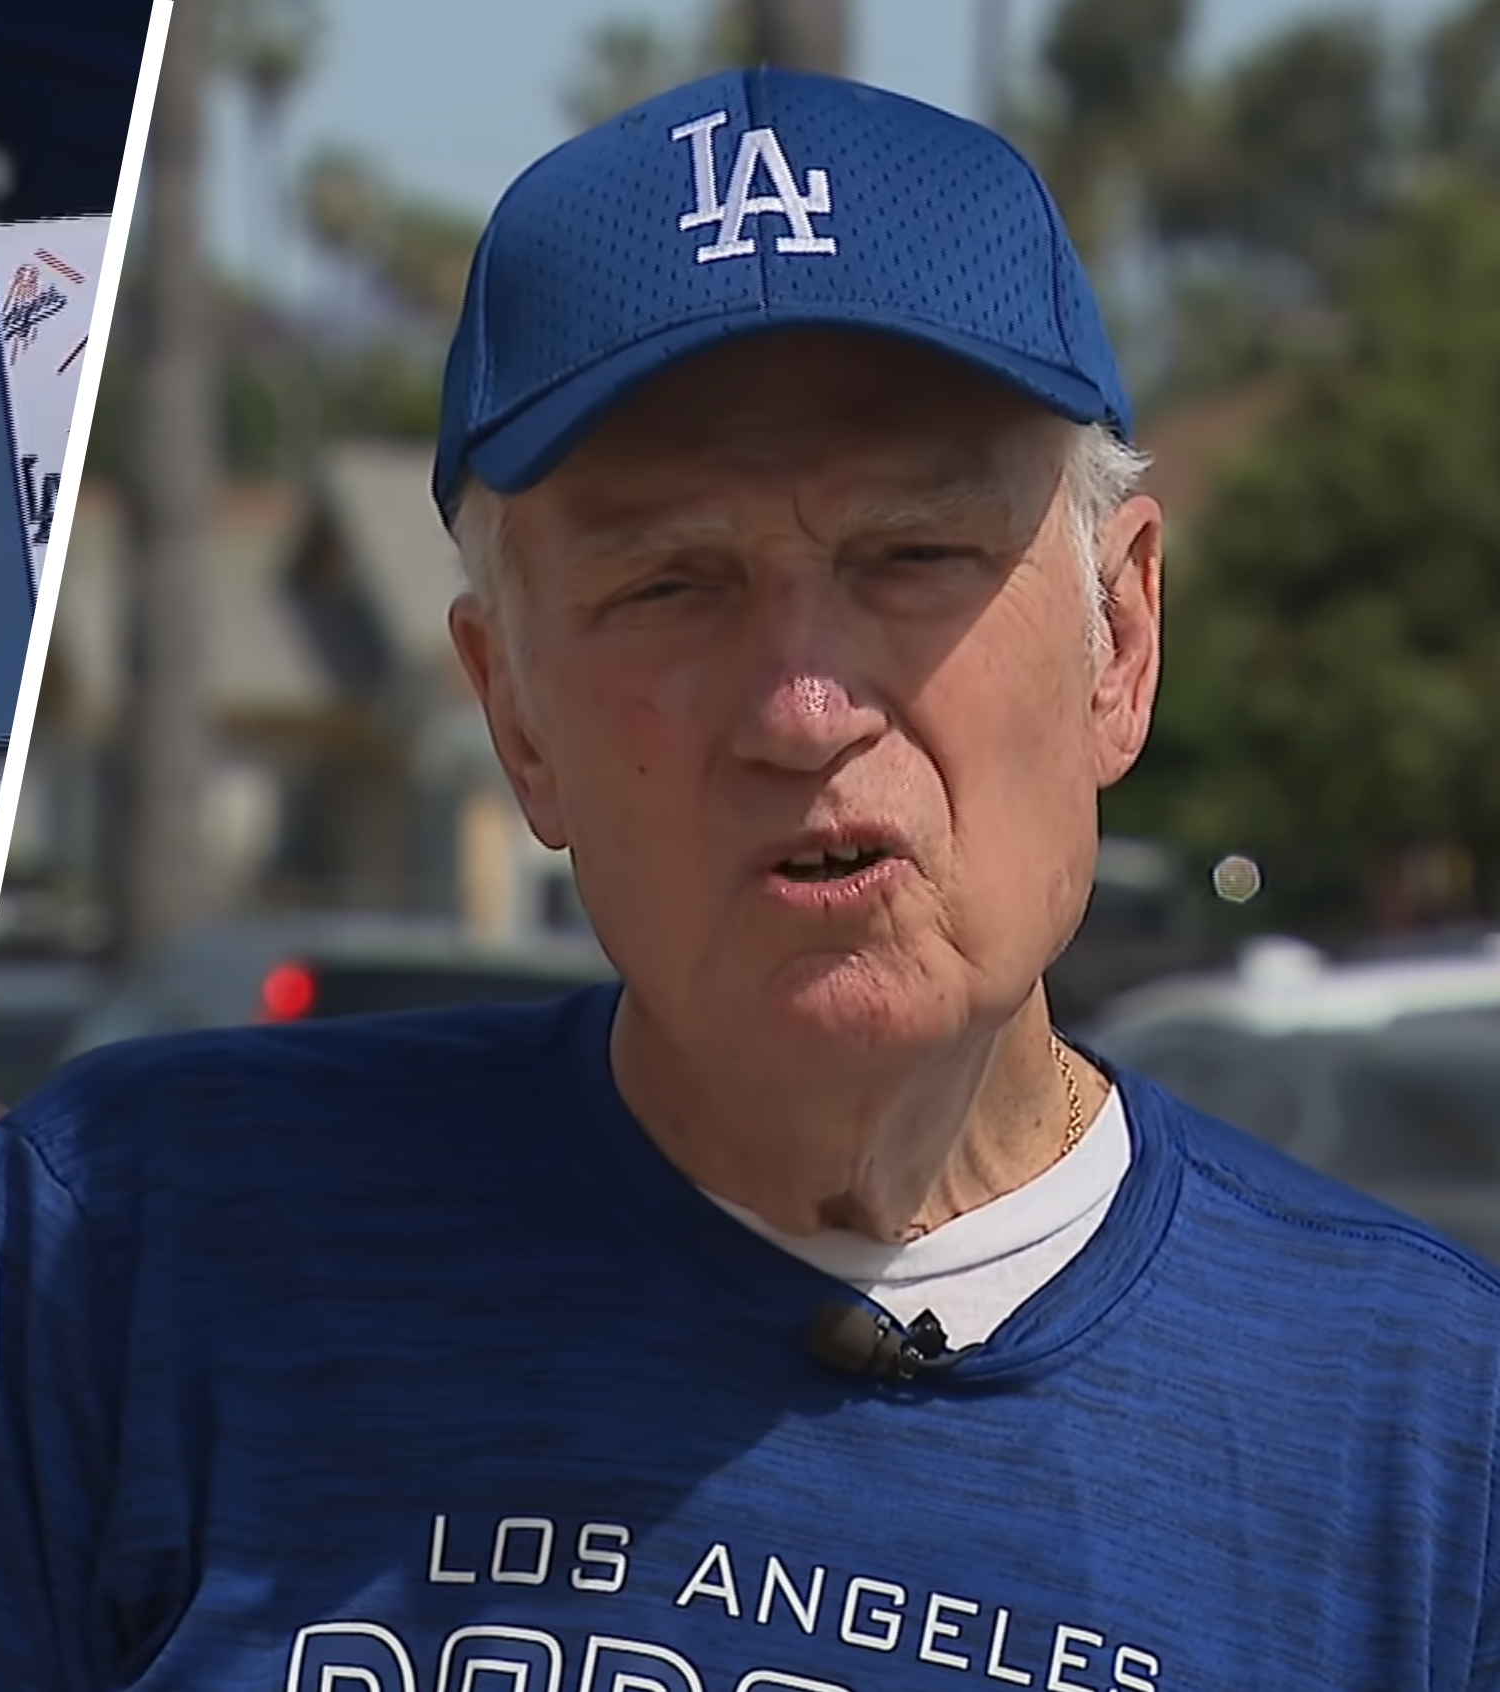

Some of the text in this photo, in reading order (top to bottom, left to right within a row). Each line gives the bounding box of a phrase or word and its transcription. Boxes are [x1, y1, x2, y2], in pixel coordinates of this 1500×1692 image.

[670, 109, 838, 264] LA
[429, 1514, 631, 1594] LOS
[676, 1542, 1161, 1692] ANGELES
